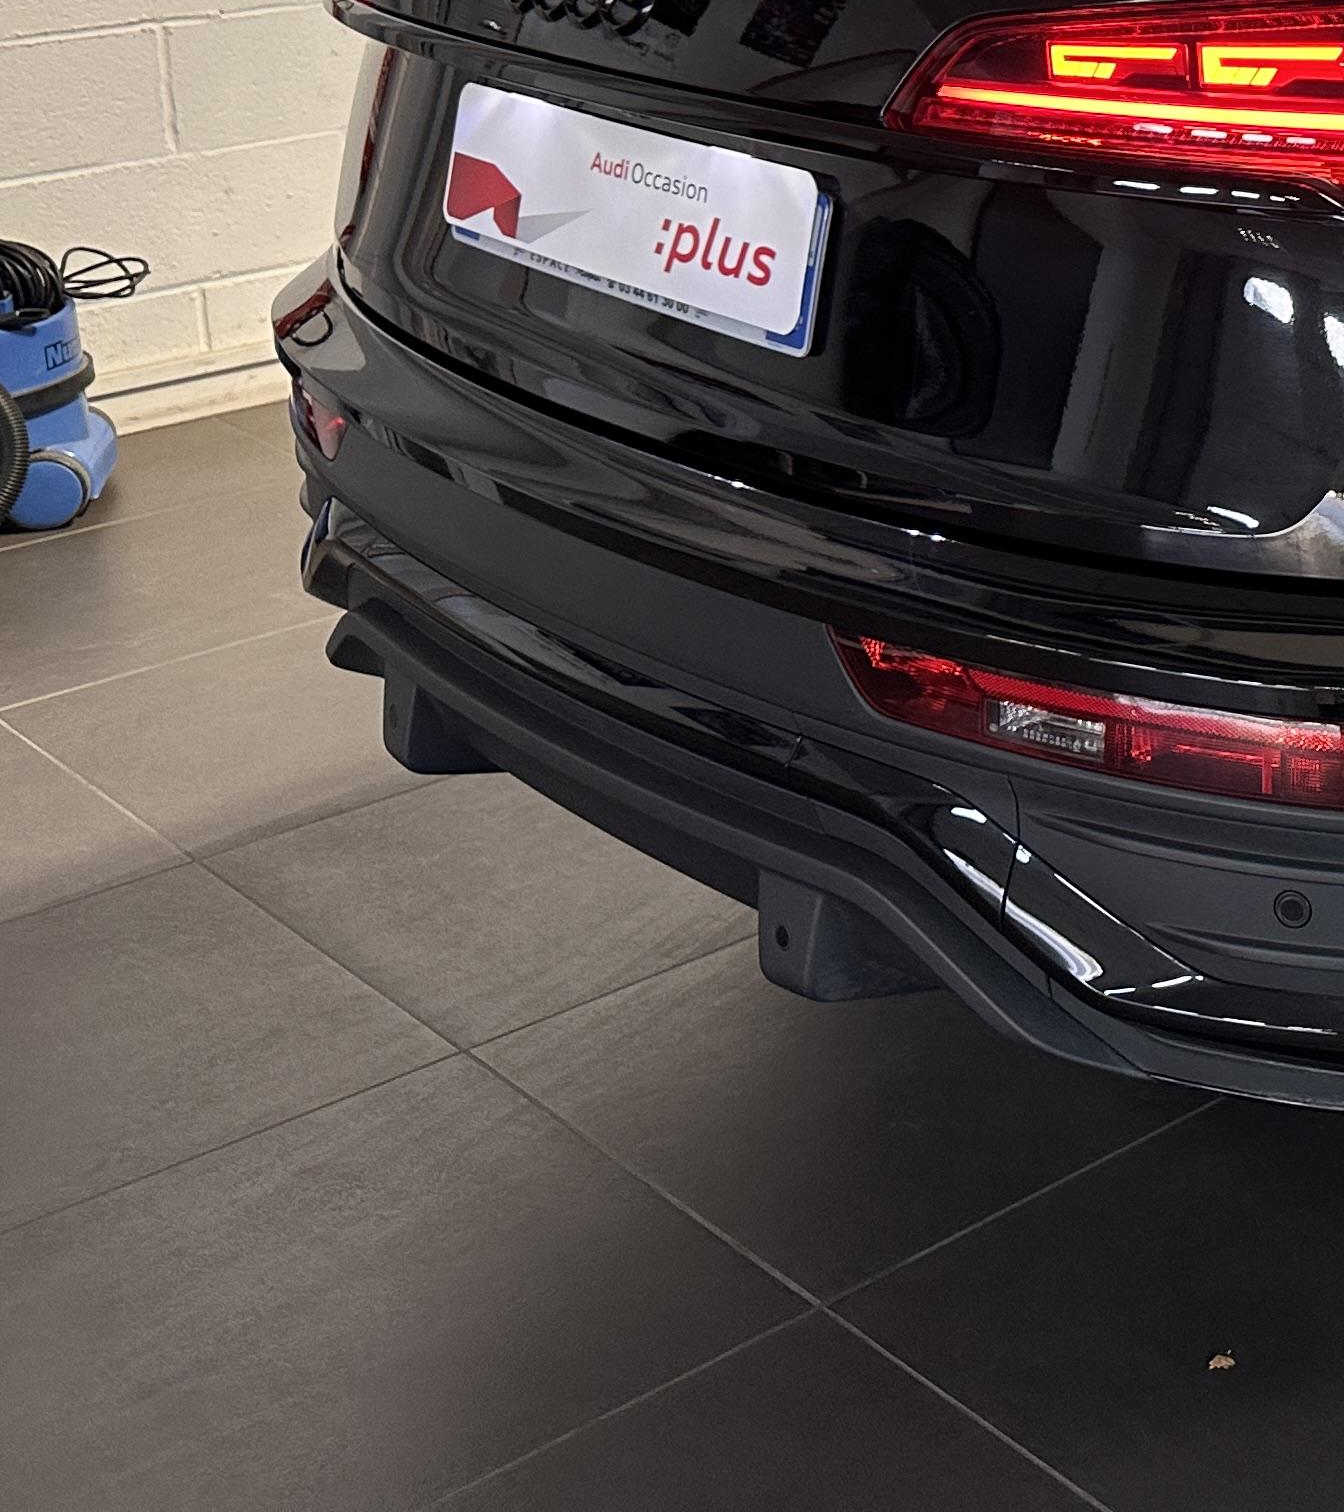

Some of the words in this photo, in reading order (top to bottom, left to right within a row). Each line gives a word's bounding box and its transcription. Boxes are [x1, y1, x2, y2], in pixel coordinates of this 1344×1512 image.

[589, 151, 630, 181] Audi
[631, 162, 709, 203] Occasion
[654, 217, 777, 286] :plus
